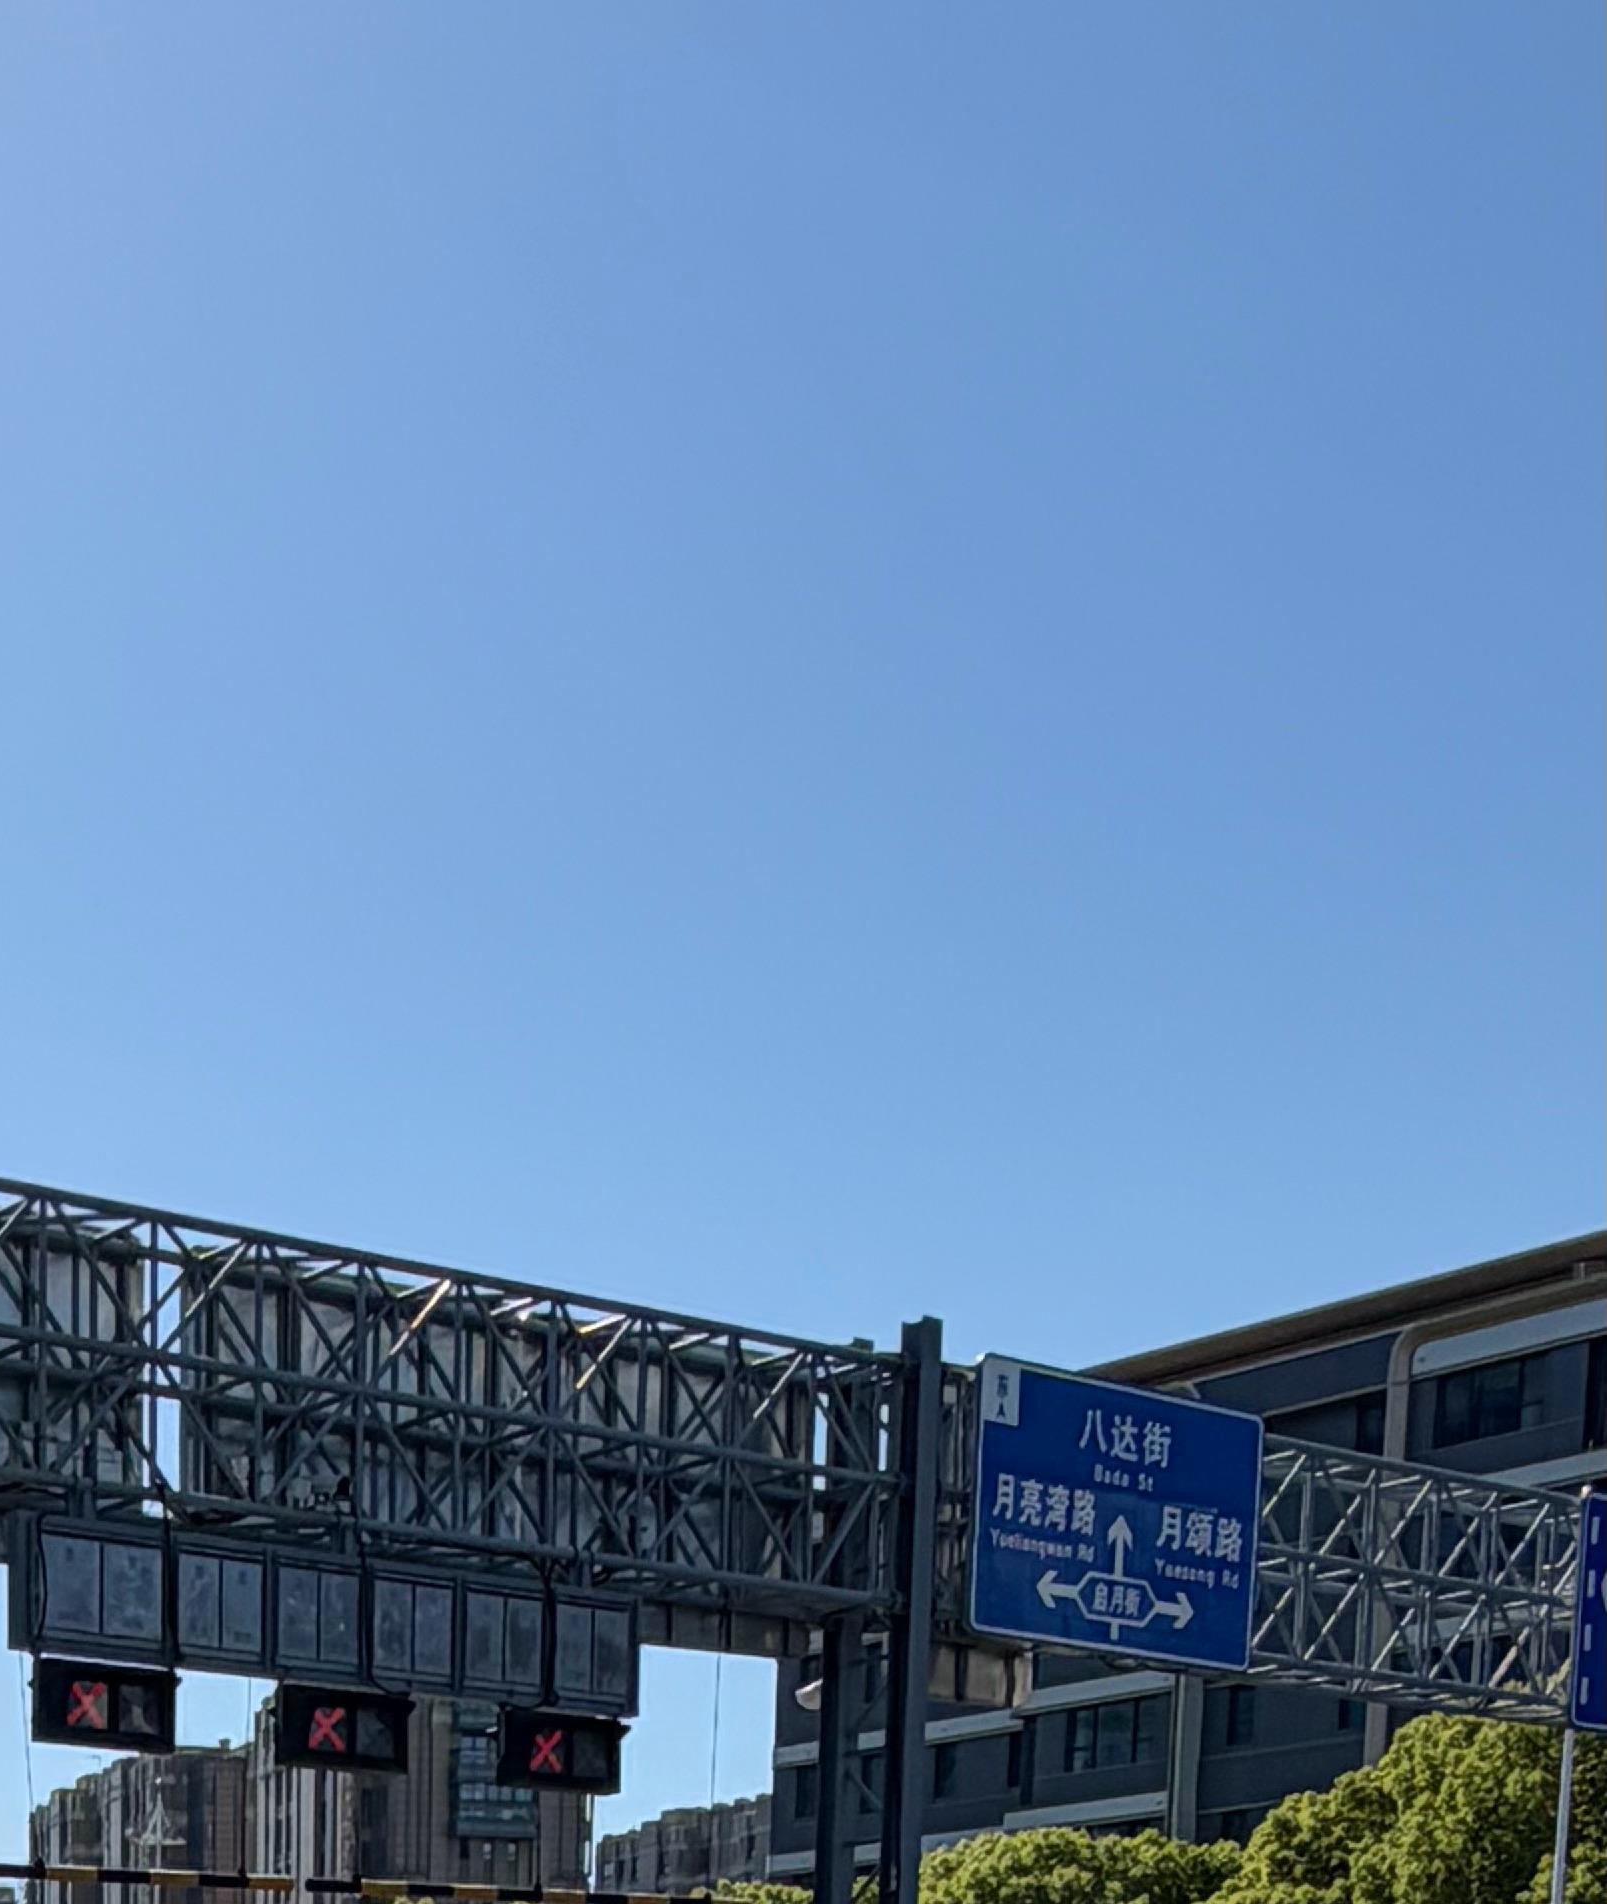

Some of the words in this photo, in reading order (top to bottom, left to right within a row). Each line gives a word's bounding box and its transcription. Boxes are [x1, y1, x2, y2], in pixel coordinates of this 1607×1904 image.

[1079, 1409, 1171, 1468] 八达街
[993, 1472, 1095, 1537] 月亮湾路
